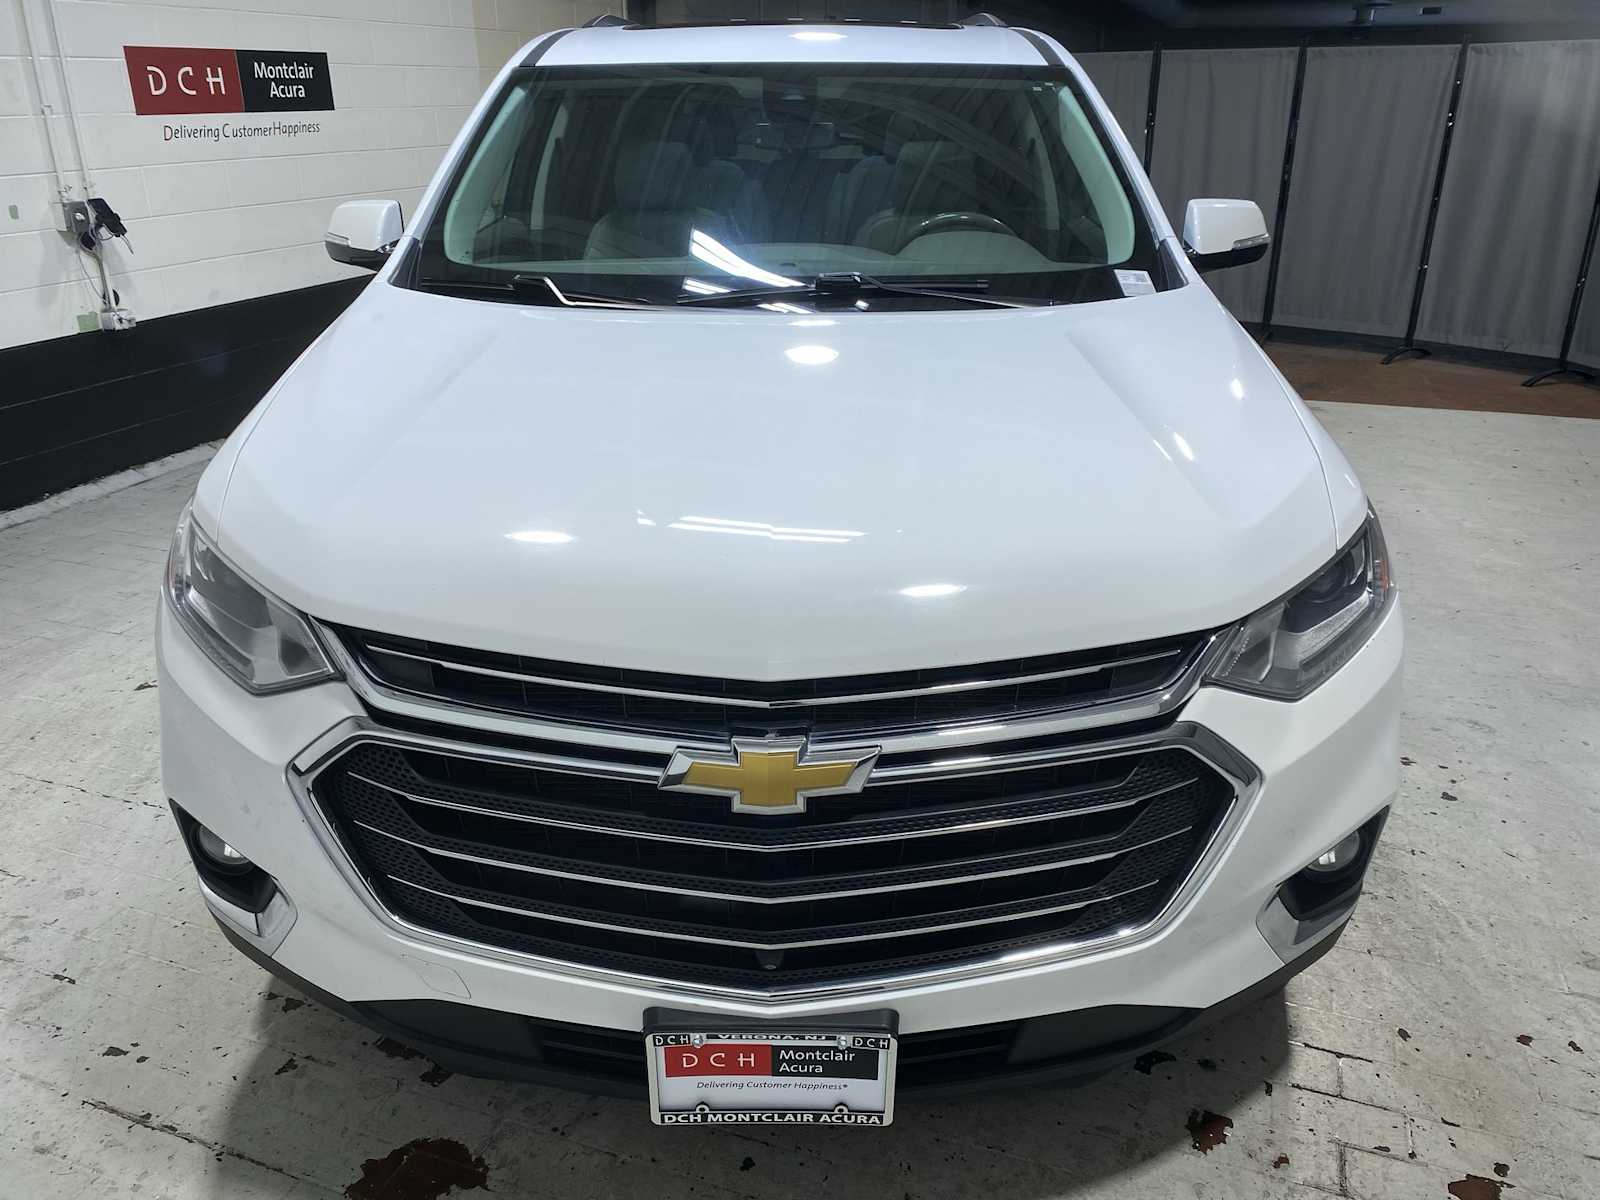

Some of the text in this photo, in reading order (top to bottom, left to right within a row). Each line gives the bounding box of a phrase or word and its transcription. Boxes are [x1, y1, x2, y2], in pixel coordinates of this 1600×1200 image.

[254, 62, 314, 79] Montclair
[147, 66, 225, 95] DCH
[269, 81, 306, 98] Acura
[163, 121, 320, 142] Delivering Customer Happiness
[655, 1035, 689, 1045] DCH
[854, 1038, 888, 1048] DCH
[682, 1053, 755, 1067] DCH
[779, 1050, 855, 1061] Montclair
[779, 1062, 823, 1073] Acura
[696, 1081, 744, 1089] Delivering
[746, 1081, 792, 1089] Customer
[664, 1113, 880, 1123] DCH MONTCLAIR ACURA
